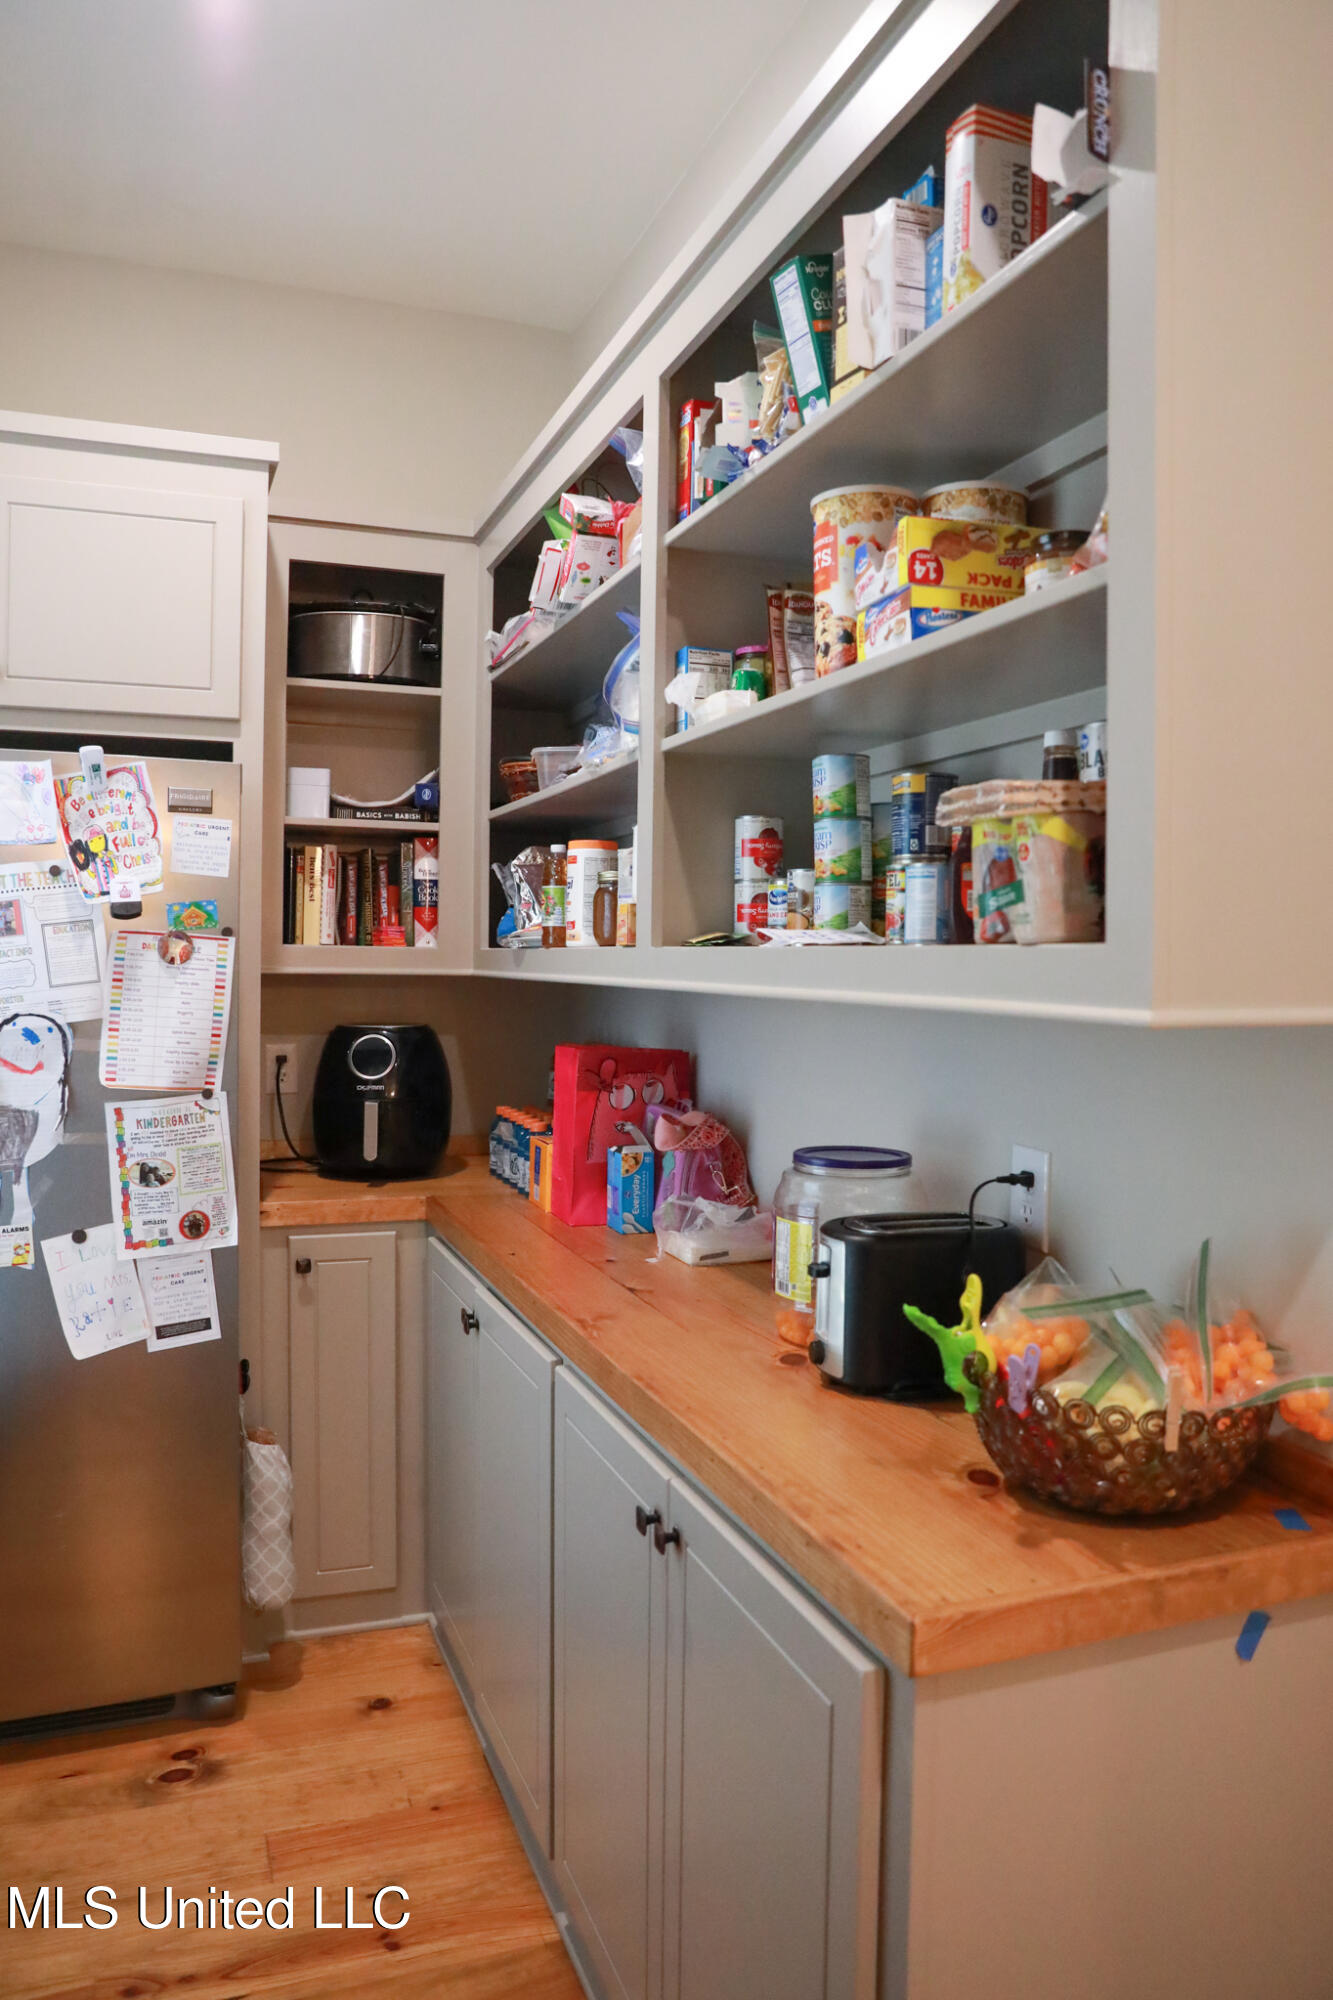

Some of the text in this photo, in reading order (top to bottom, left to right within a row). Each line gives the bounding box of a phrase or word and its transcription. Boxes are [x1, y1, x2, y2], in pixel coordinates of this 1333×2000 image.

[1092, 68, 1109, 156] CRUNCH
[1011, 162, 1028, 260] OPCORN
[805, 261, 830, 278] Kroger
[813, 300, 833, 312] CLU
[914, 560, 937, 580] 14
[967, 572, 1013, 589] PACK
[960, 592, 1009, 609] FAMI
[356, 811, 382, 819] BASICS
[395, 812, 421, 820] BABISH
[106, 816, 129, 833] and
[35, 869, 76, 887] TEACH
[136, 1112, 206, 1130] KINDERGARTEN
[631, 1174, 641, 1215] Everyday
[1, 1226, 30, 1234] ALARMS
[182, 1269, 205, 1277] URGENT
